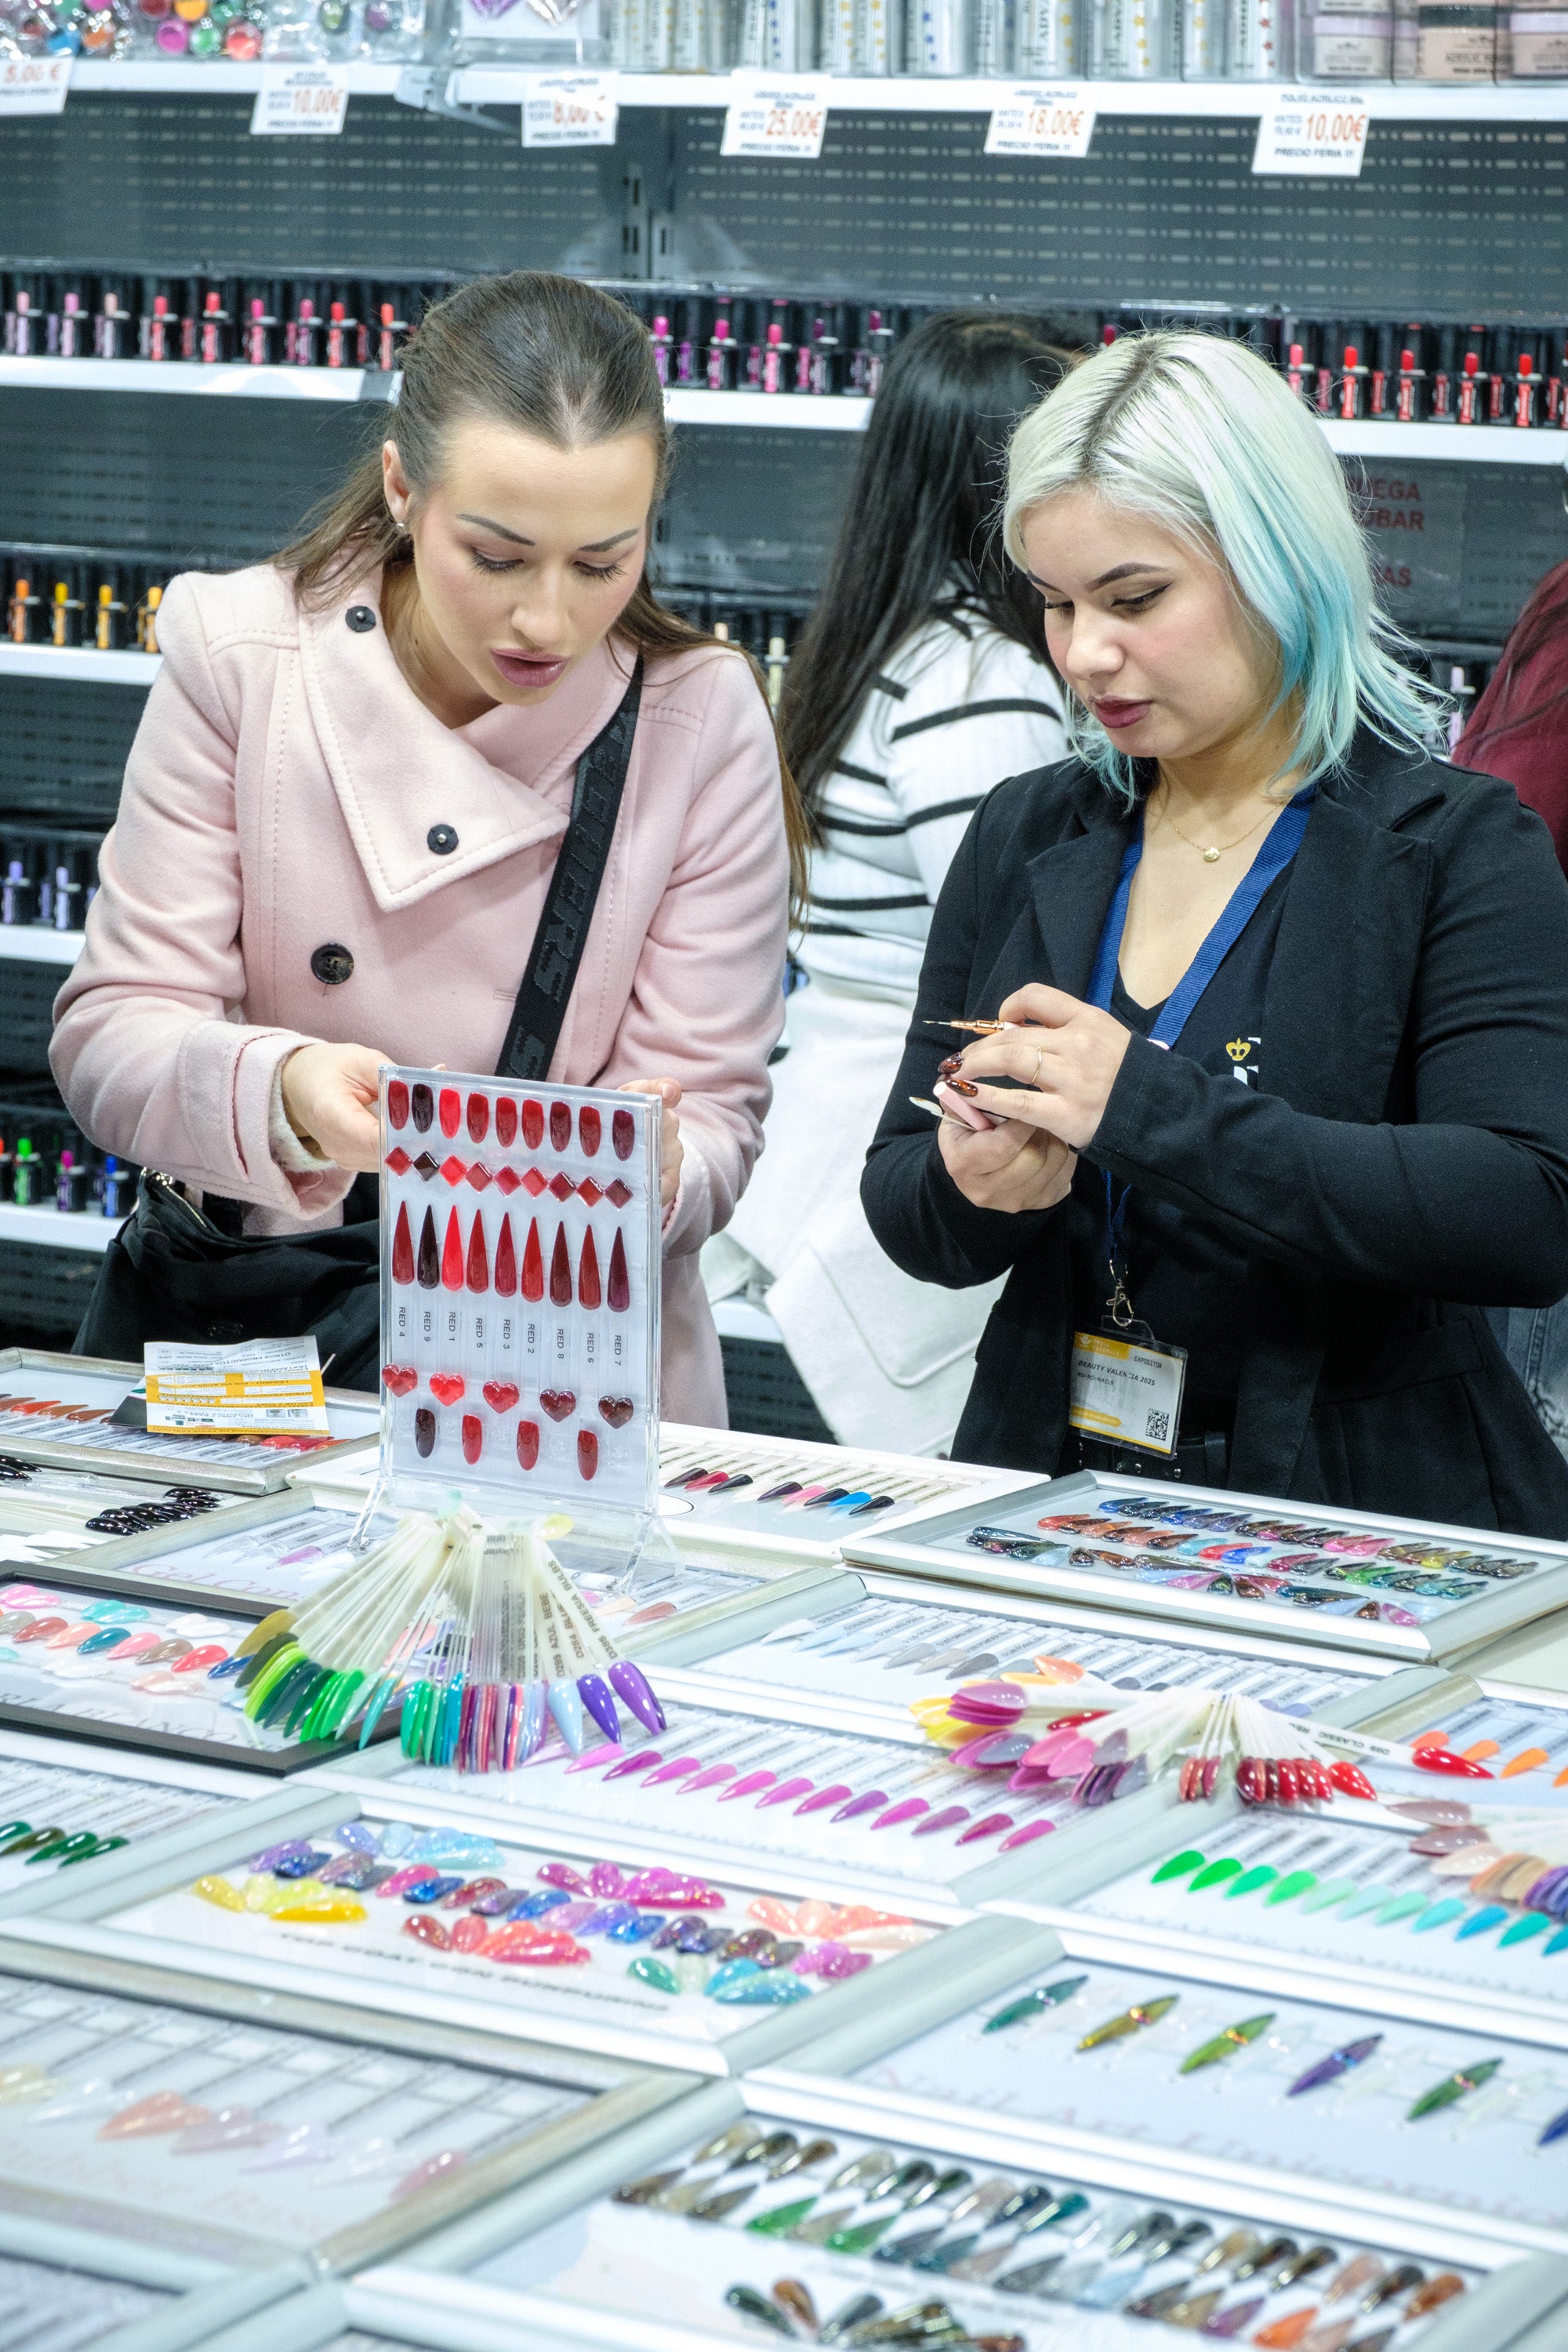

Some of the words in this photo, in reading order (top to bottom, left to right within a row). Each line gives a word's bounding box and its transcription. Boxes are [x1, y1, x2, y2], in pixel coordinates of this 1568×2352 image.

[1028, 108, 1084, 136] 18,00€
[1306, 114, 1366, 145] 10,00€
[1346, 477, 1421, 502] UEGA
[1078, 1360, 1105, 1371] BEAUTY
[1106, 1367, 1139, 1381] VALENCIA
[1140, 1376, 1156, 1386] 2025
[1134, 1356, 1162, 1369] EXPOSITOR
[548, 1559, 573, 1592] BULBS
[539, 1592, 553, 1620] BEBE
[571, 1593, 601, 1633] FREESIA
[547, 1622, 559, 1649] AZUL
[569, 1634, 585, 1659] D284
[598, 1635, 618, 1660] D385
[553, 1653, 565, 1678] D289
[1318, 1731, 1365, 1748] CLASSIC
